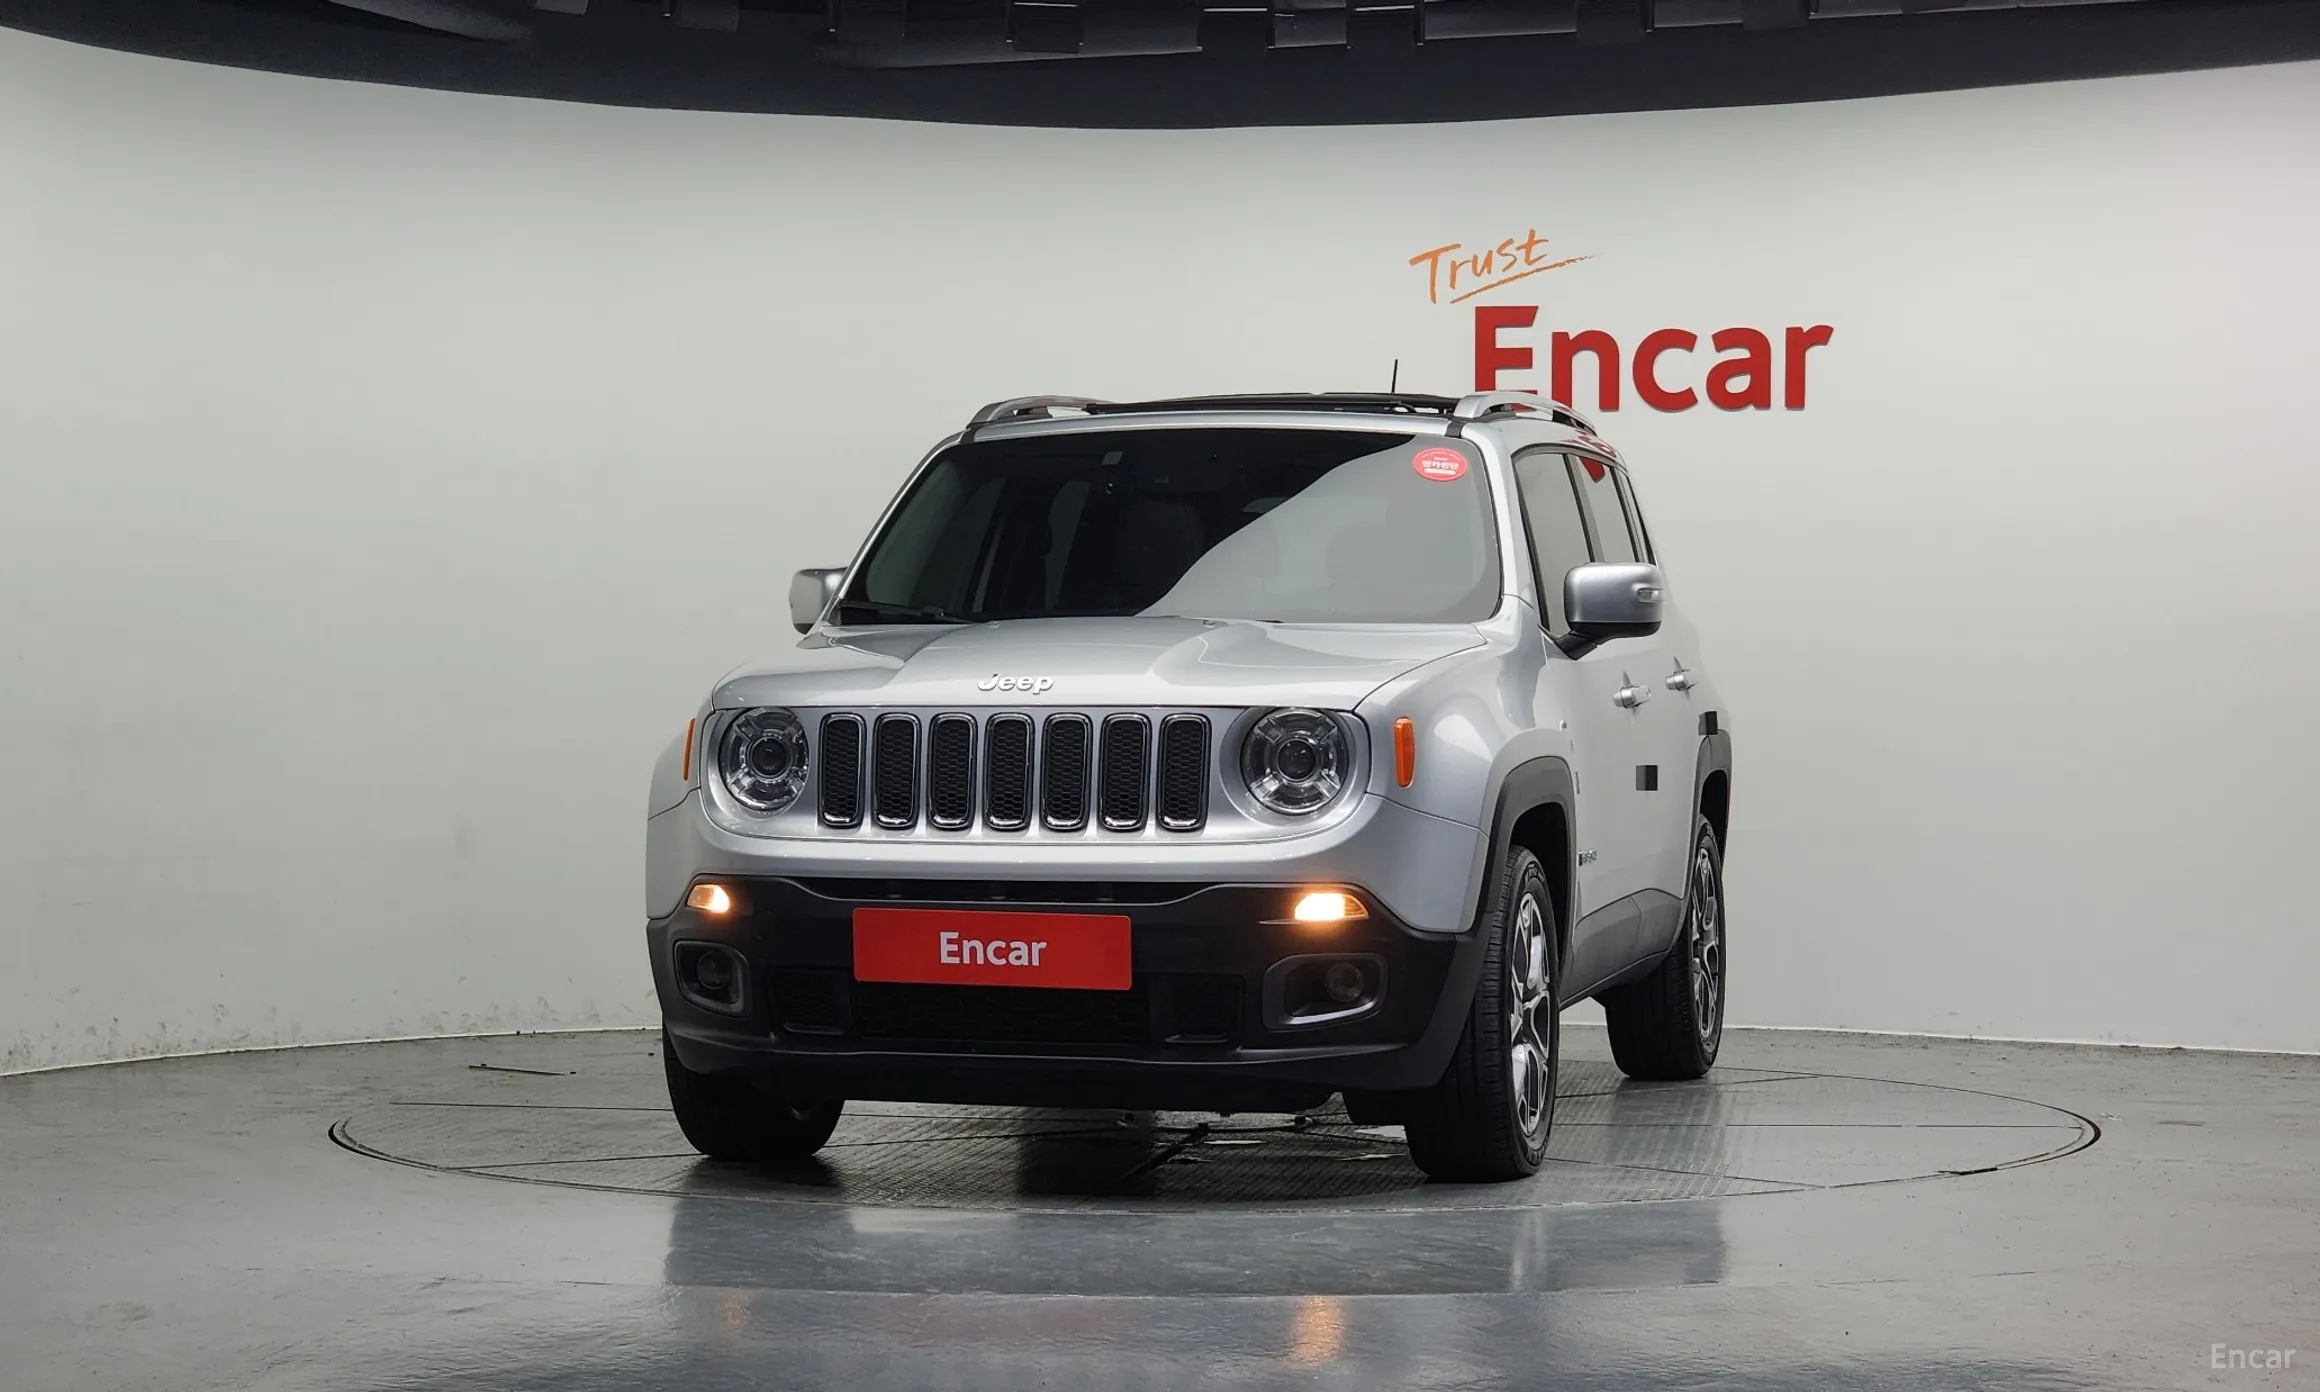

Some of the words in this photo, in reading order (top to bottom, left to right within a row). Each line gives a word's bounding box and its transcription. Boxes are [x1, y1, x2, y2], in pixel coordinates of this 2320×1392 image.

[1409, 228, 1549, 304] Trust
[1475, 305, 1834, 412] Encar
[977, 672, 1054, 695] Jeep
[940, 931, 1047, 967] Encar
